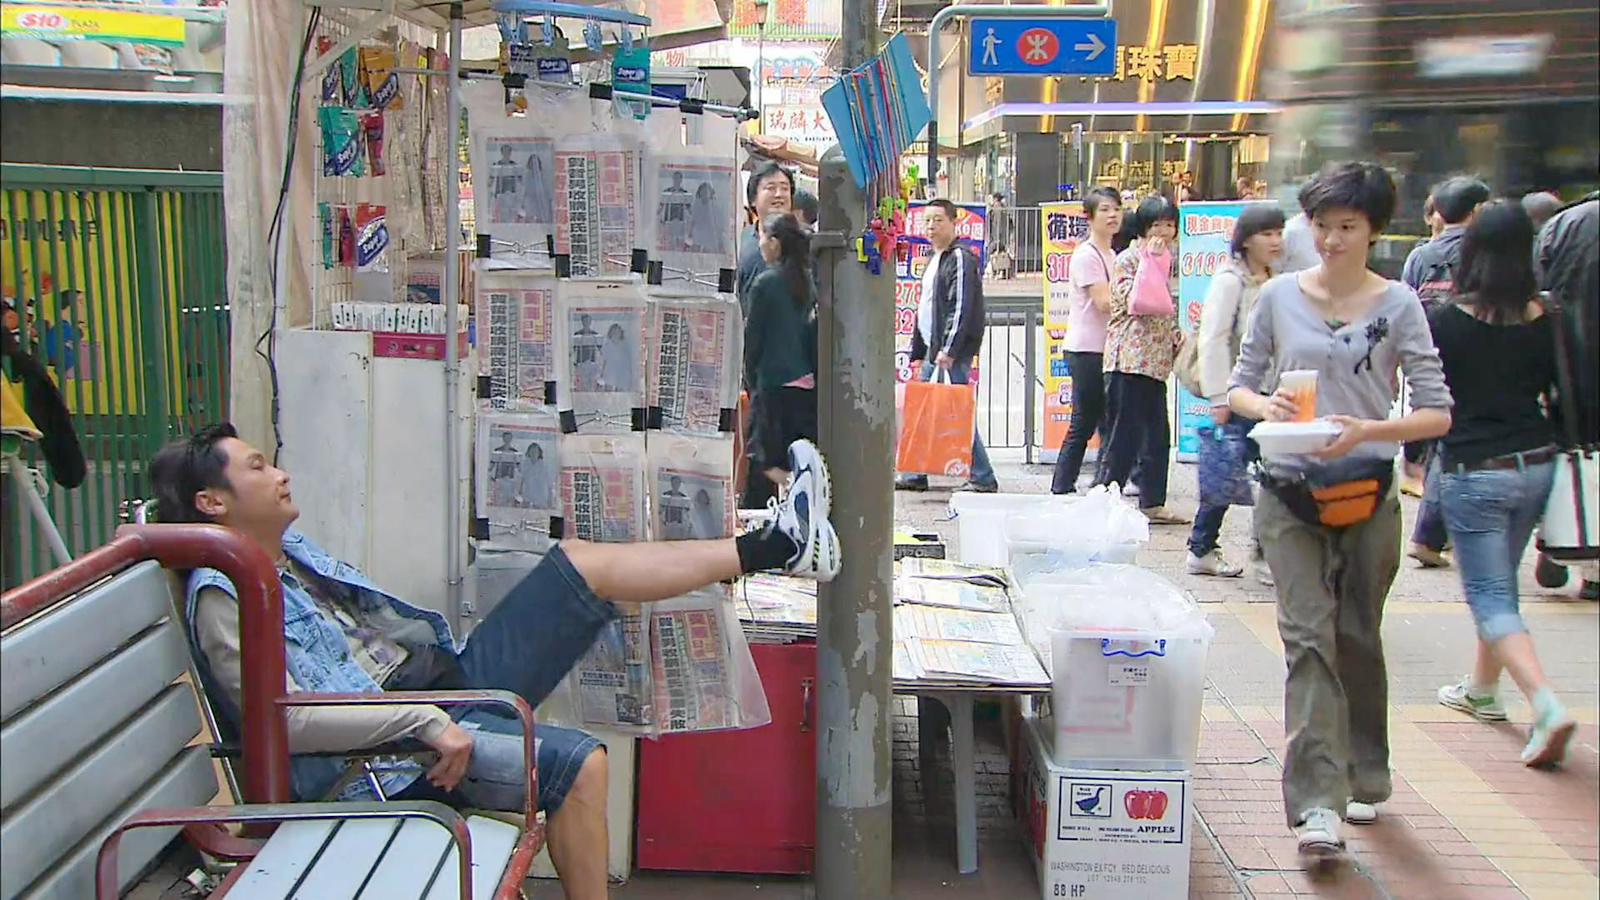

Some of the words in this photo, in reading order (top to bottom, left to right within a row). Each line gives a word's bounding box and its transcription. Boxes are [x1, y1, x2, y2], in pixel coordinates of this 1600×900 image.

[22, 13, 62, 28] $10
[1137, 825, 1175, 834] APPLES
[1050, 861, 1093, 872] WASHINGTON
[1121, 864, 1136, 874] RED
[1137, 864, 1171, 874] DELICIOUS
[1053, 883, 1066, 897] 88
[1070, 884, 1086, 897] HP
